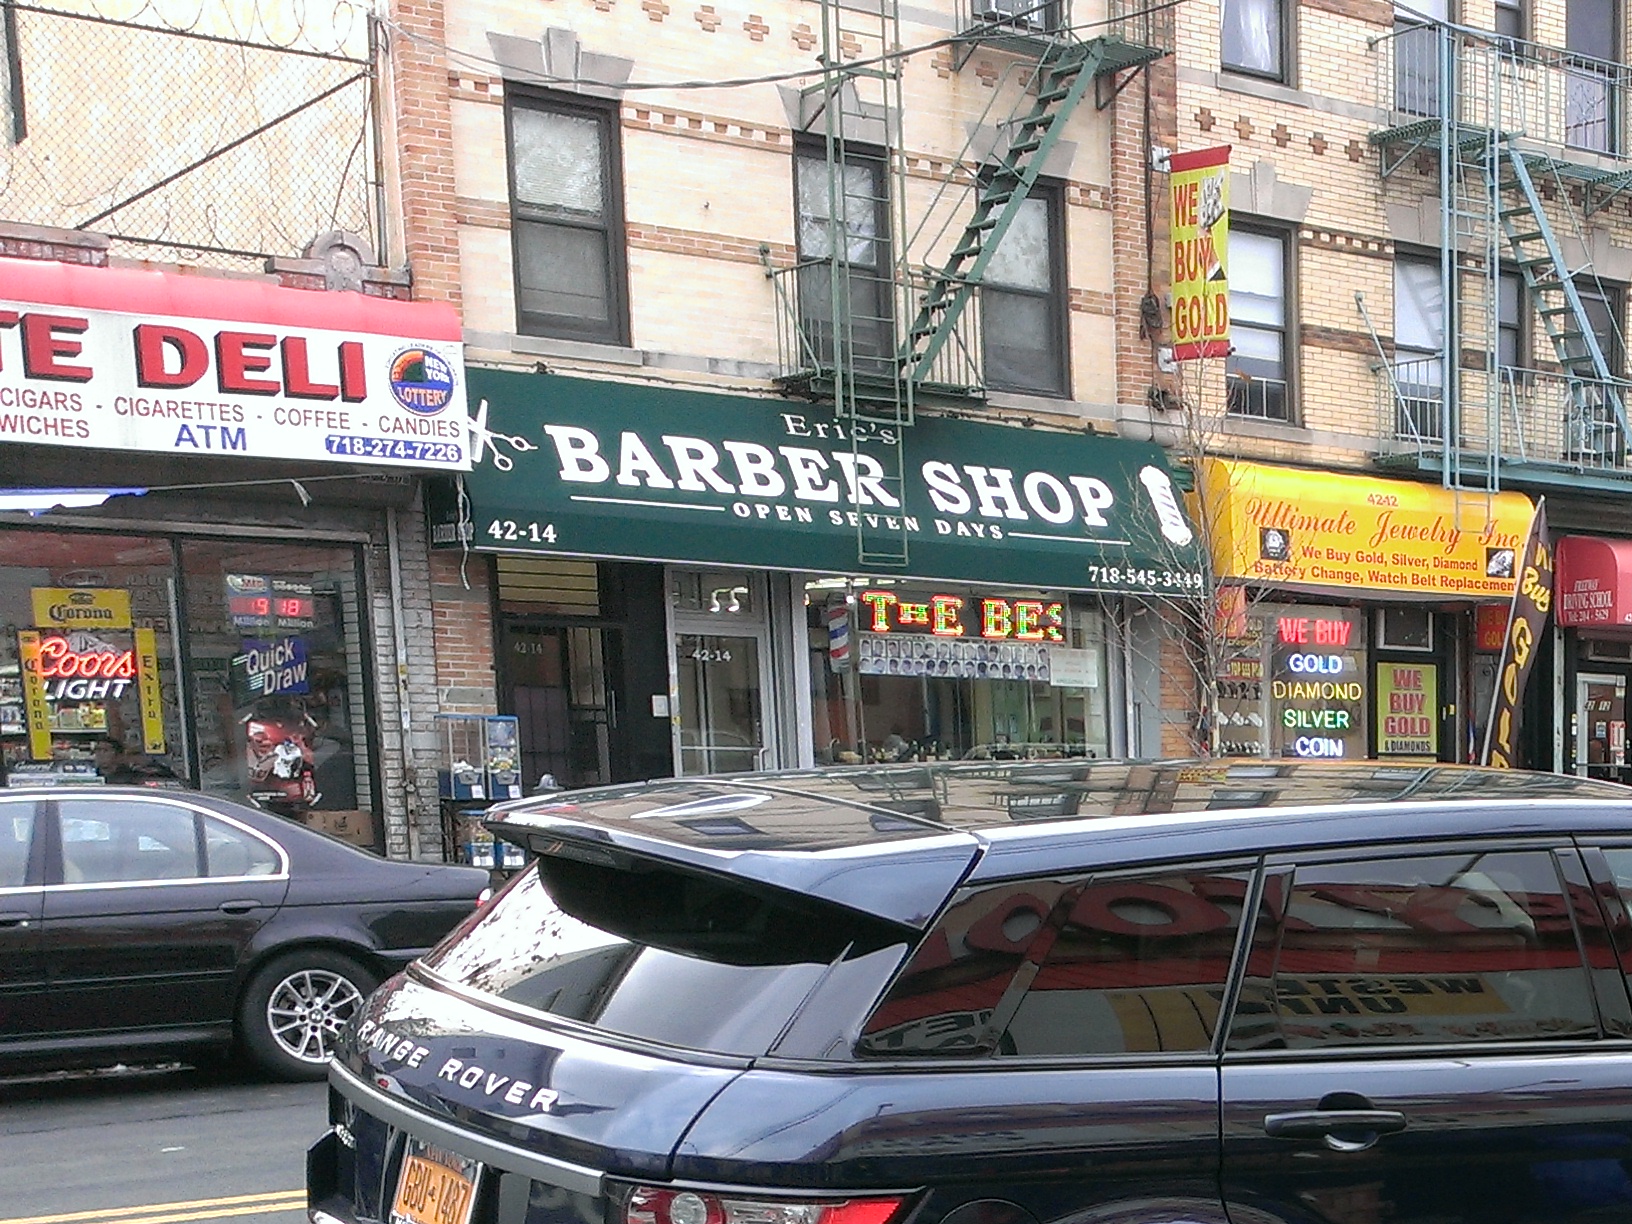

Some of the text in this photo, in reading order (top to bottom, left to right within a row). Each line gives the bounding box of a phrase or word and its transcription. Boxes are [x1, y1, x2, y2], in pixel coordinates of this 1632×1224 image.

[1173, 182, 1198, 227] WE
[1174, 235, 1213, 283] BUY
[1174, 293, 1228, 340] GOLD
[133, 322, 368, 404] DELI
[397, 386, 449, 407] LOTTERY
[0, 387, 462, 439] CIGARS CIGARETTES COFFEE CANDIES
[174, 423, 249, 452] ATM
[781, 412, 898, 446] Eric's
[328, 435, 461, 463] 718-274-7226
[543, 423, 1114, 528] BARBER SHOP
[487, 519, 557, 544] 42-14
[733, 501, 1004, 541] OPEN SEVEN DAYS
[1245, 496, 1526, 554] Ultimate Jewelry Inc.
[1302, 545, 1478, 572] We Buy Gold, Silver, Diamond
[1253, 561, 1517, 593] Battery Change, Watch Belt Replacemen
[1520, 565, 1551, 613] Buy
[49, 603, 114, 622] Corona
[277, 617, 314, 629] Million
[861, 589, 964, 637] THE
[1278, 617, 1309, 644] WE
[1314, 618, 1352, 646] BUY
[39, 635, 136, 678] Coors
[246, 638, 295, 675] Quick
[691, 648, 732, 663] 42-14
[1288, 653, 1343, 674] GOLD
[43, 679, 132, 700] LIGHT
[263, 661, 308, 695] Draw
[1272, 680, 1362, 701] DIAMOND
[1392, 668, 1423, 690] WE
[1389, 692, 1426, 714] BUY
[1283, 708, 1350, 729] SILVER
[1384, 715, 1431, 737] GOLD
[1295, 736, 1344, 757] COIN
[356, 1019, 560, 1113] RANGE ROVER
